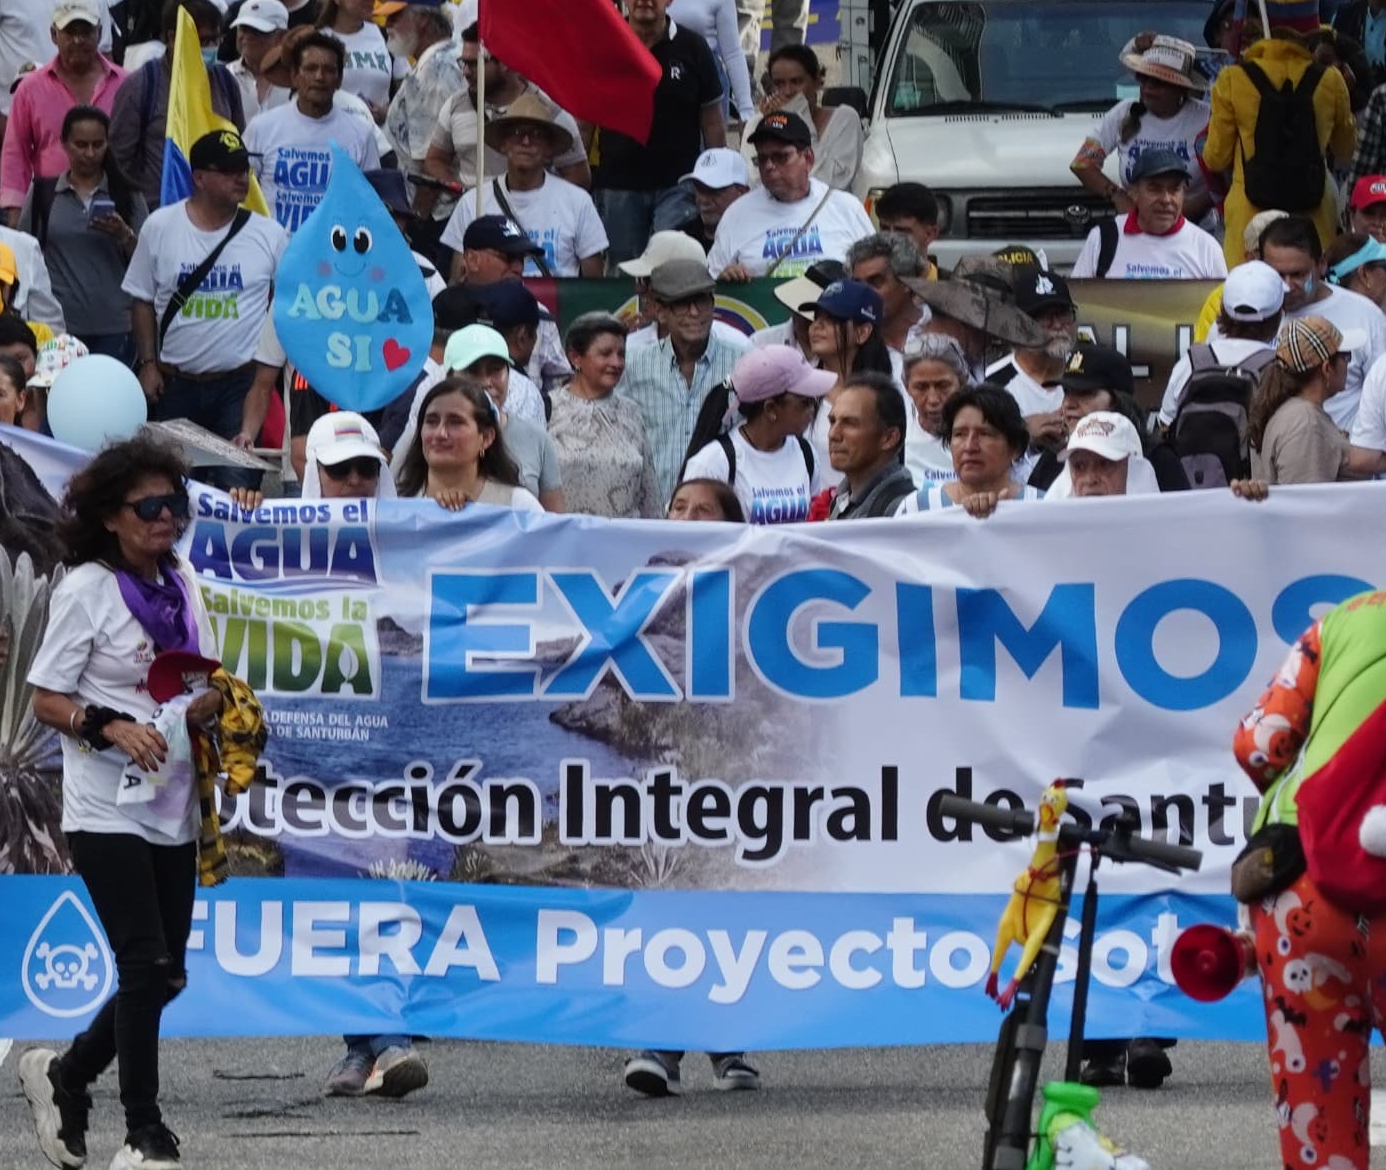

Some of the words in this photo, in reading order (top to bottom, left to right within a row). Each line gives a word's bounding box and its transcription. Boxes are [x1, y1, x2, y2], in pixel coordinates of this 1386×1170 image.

[277, 147, 331, 161] Salvemos
[273, 158, 332, 188] AGU
[275, 190, 325, 205] Salvemo
[997, 251, 1033, 264] OLICIA
[1125, 262, 1170, 275] Salvemos
[179, 293, 240, 320] VIDA
[290, 283, 413, 325] AGUA
[326, 331, 373, 373] SI
[752, 487, 792, 500] Salvemos
[197, 495, 331, 522] Salvemos
[341, 497, 369, 522] el
[749, 496, 809, 527] AGUA
[189, 522, 378, 583] AGUA
[201, 591, 333, 621] Salvemos
[340, 591, 368, 621] la
[211, 622, 375, 695] VIDA
[271, 711, 324, 726] DEFENSA
[328, 713, 349, 726] DEL
[355, 715, 389, 729] AGUA
[276, 725, 292, 738] DE
[296, 723, 370, 742] SANTURBÁN
[217, 760, 538, 840] otección
[564, 764, 898, 863] Integral
[927, 766, 1035, 843] de
[186, 900, 500, 982] FUERA
[534, 908, 994, 1004] Proyecto
